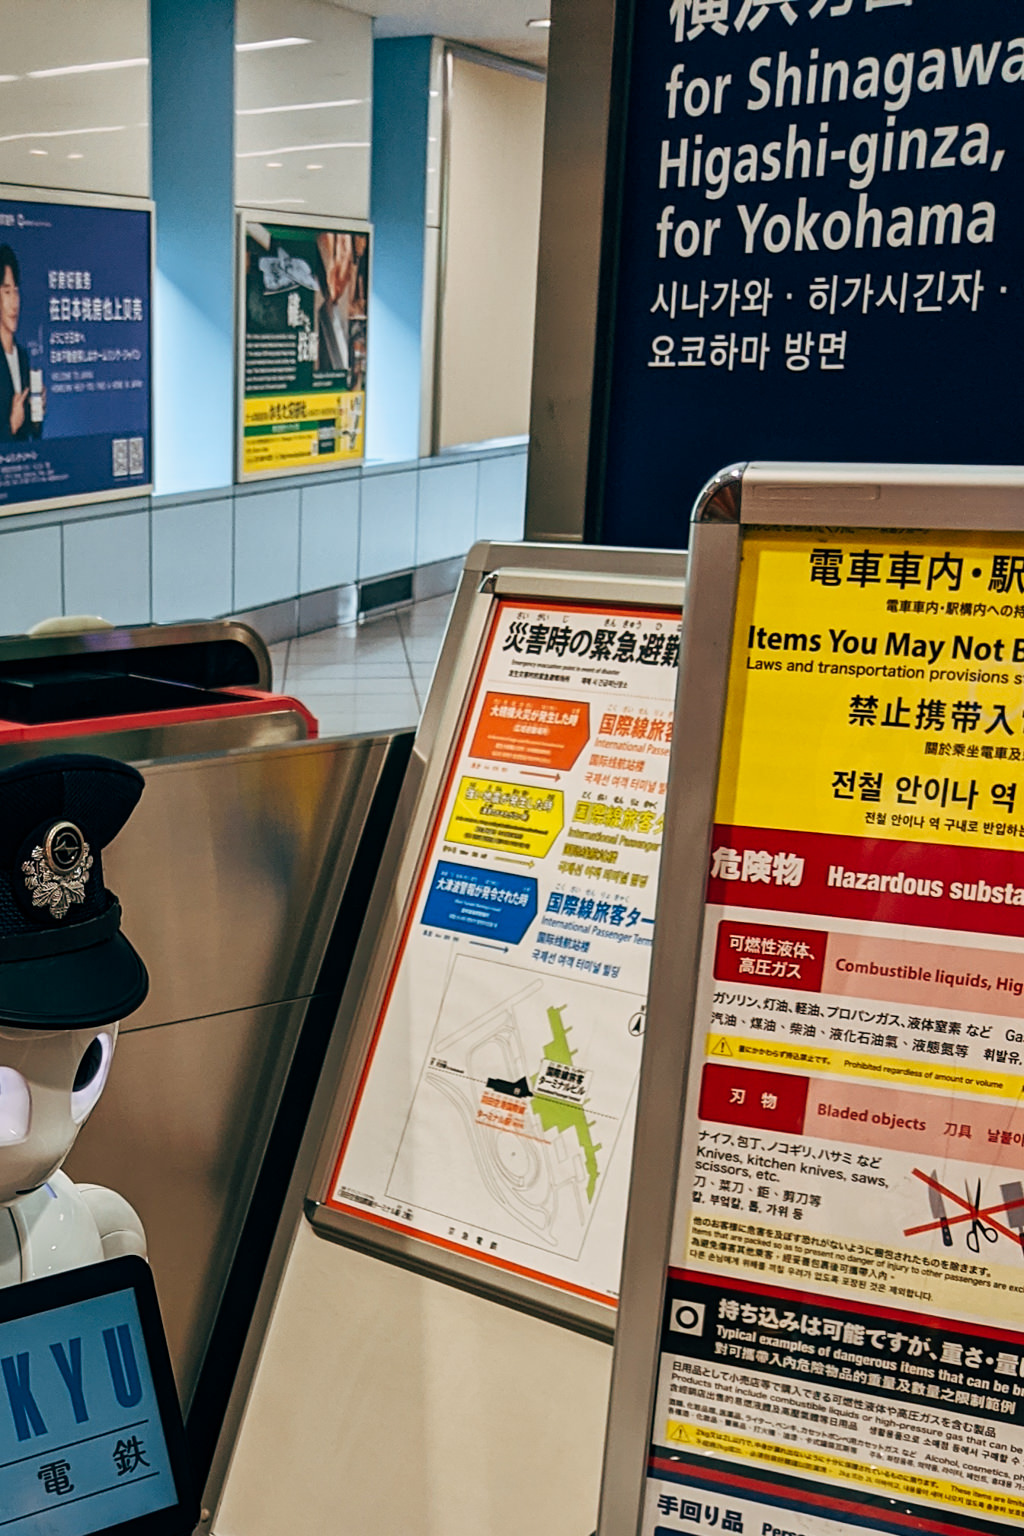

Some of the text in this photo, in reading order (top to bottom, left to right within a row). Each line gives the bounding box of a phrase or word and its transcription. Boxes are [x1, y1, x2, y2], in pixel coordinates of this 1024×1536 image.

[666, 37, 1024, 119] for Shinagawa
[658, 115, 1005, 200] Higashi-ginza,
[656, 193, 995, 259] for Yokohama
[650, 269, 983, 319] 시나가와 히가시긴자
[648, 330, 848, 371] 요코하마 방면
[810, 548, 1024, 593] 電車車内・駅
[503, 623, 680, 667] 災害時の緊急避難
[747, 625, 1005, 664] Items You May Not
[746, 656, 1009, 684] Laws and transportation provisions
[832, 771, 1016, 813] 전철 안이나 역
[865, 812, 978, 832] 전철 안이나 역 구내로
[711, 847, 804, 886] 危険物
[828, 866, 943, 897] Hazardous
[730, 935, 814, 959] 可燃性液体、
[739, 957, 801, 979] 高圧ガス
[836, 959, 931, 981] Combustible
[935, 969, 991, 990] liquids,
[966, 1024, 992, 1038] など
[844, 1060, 882, 1071] Prohibited
[883, 1067, 922, 1077] regardless
[932, 1072, 963, 1083] amount
[976, 1080, 1003, 1088] volume
[818, 1104, 926, 1130] Bladed objects
[944, 1123, 972, 1139] 刀具
[696, 1146, 888, 1188] Knives, kitchen knives, saws,
[698, 1131, 882, 1169] ナイフ、包丁、ノコギリ、ハサミ など
[694, 1161, 779, 1182] scissors, etc.
[766, 1204, 788, 1217] 가위
[712, 1231, 728, 1243] that
[742, 1238, 771, 1251] packed
[847, 1255, 874, 1265] danger
[921, 1269, 943, 1278] other
[944, 1274, 991, 1287] passengers
[993, 1282, 1007, 1290] are
[716, 1325, 1009, 1393] Typical examples of dangerous items that can be
[671, 1372, 1023, 1454] Products that include combustible liquids or high-pressure gas that can be
[925, 1454, 1010, 1479] Alcohol, cosmetics,
[657, 1494, 743, 1534] 手回り品
